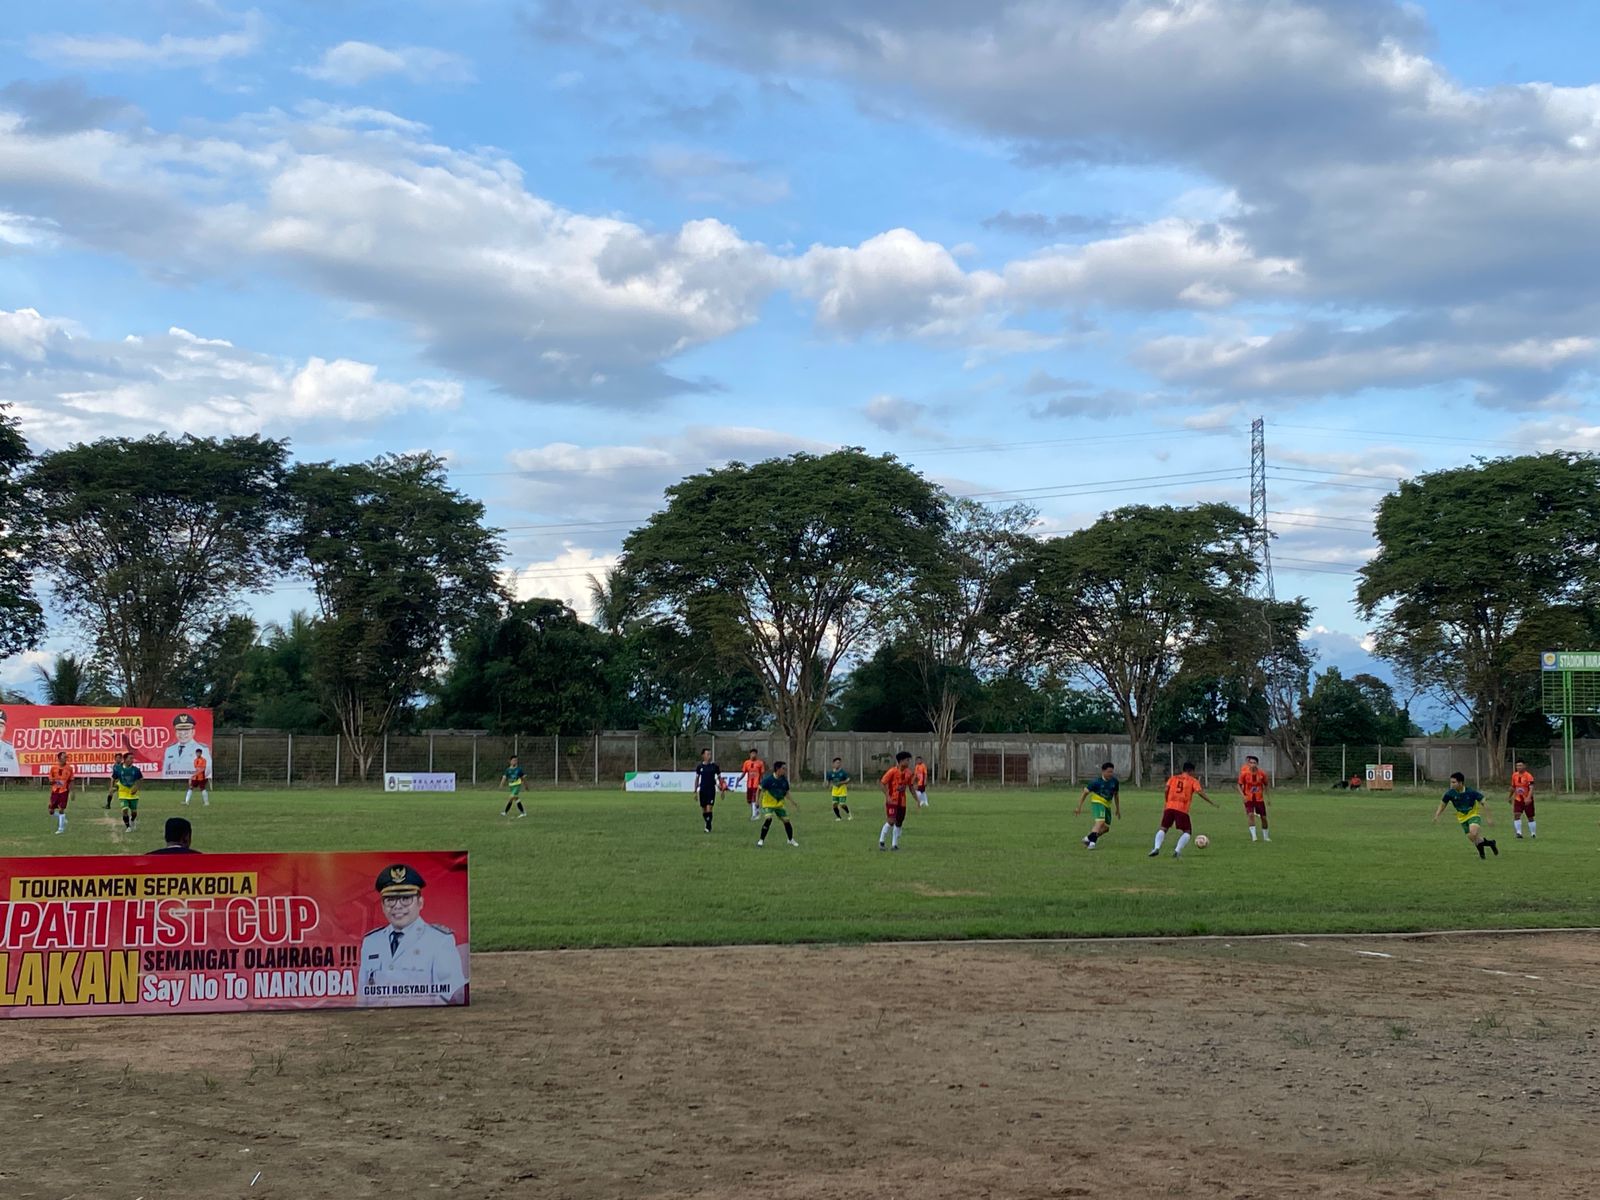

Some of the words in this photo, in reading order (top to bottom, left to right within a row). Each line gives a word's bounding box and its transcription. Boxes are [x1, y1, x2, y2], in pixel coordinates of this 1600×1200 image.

[1560, 655, 1584, 668] STADION
[43, 719, 92, 728] TOURNAMEN
[95, 718, 141, 727] SEPAKBOLA
[13, 728, 82, 750] BUPATI
[86, 727, 124, 749] HST
[129, 727, 170, 749] CUP
[24, 753, 59, 764] SELAMA
[67, 753, 116, 763] BERTANDIN
[76, 764, 105, 773] TINGGI
[1367, 770, 1374, 780] 0
[1385, 770, 1391, 780] 0
[1176, 780, 1183, 793] 9
[19, 878, 137, 898] TOURNAMEN
[143, 876, 253, 896] SEPAKBOLA
[123, 898, 214, 947] HST
[226, 896, 319, 945] CUP
[144, 949, 239, 971] SEMANGAT
[244, 946, 335, 969] OLAHRAGA
[340, 946, 358, 967] !!!
[142, 973, 185, 1006] Say
[189, 972, 219, 1000] No
[223, 971, 249, 999] To
[253, 969, 355, 999] NARKOBA
[364, 985, 390, 995] GUSTI
[392, 984, 429, 995] ROSYADI
[431, 984, 451, 994] ELMI
